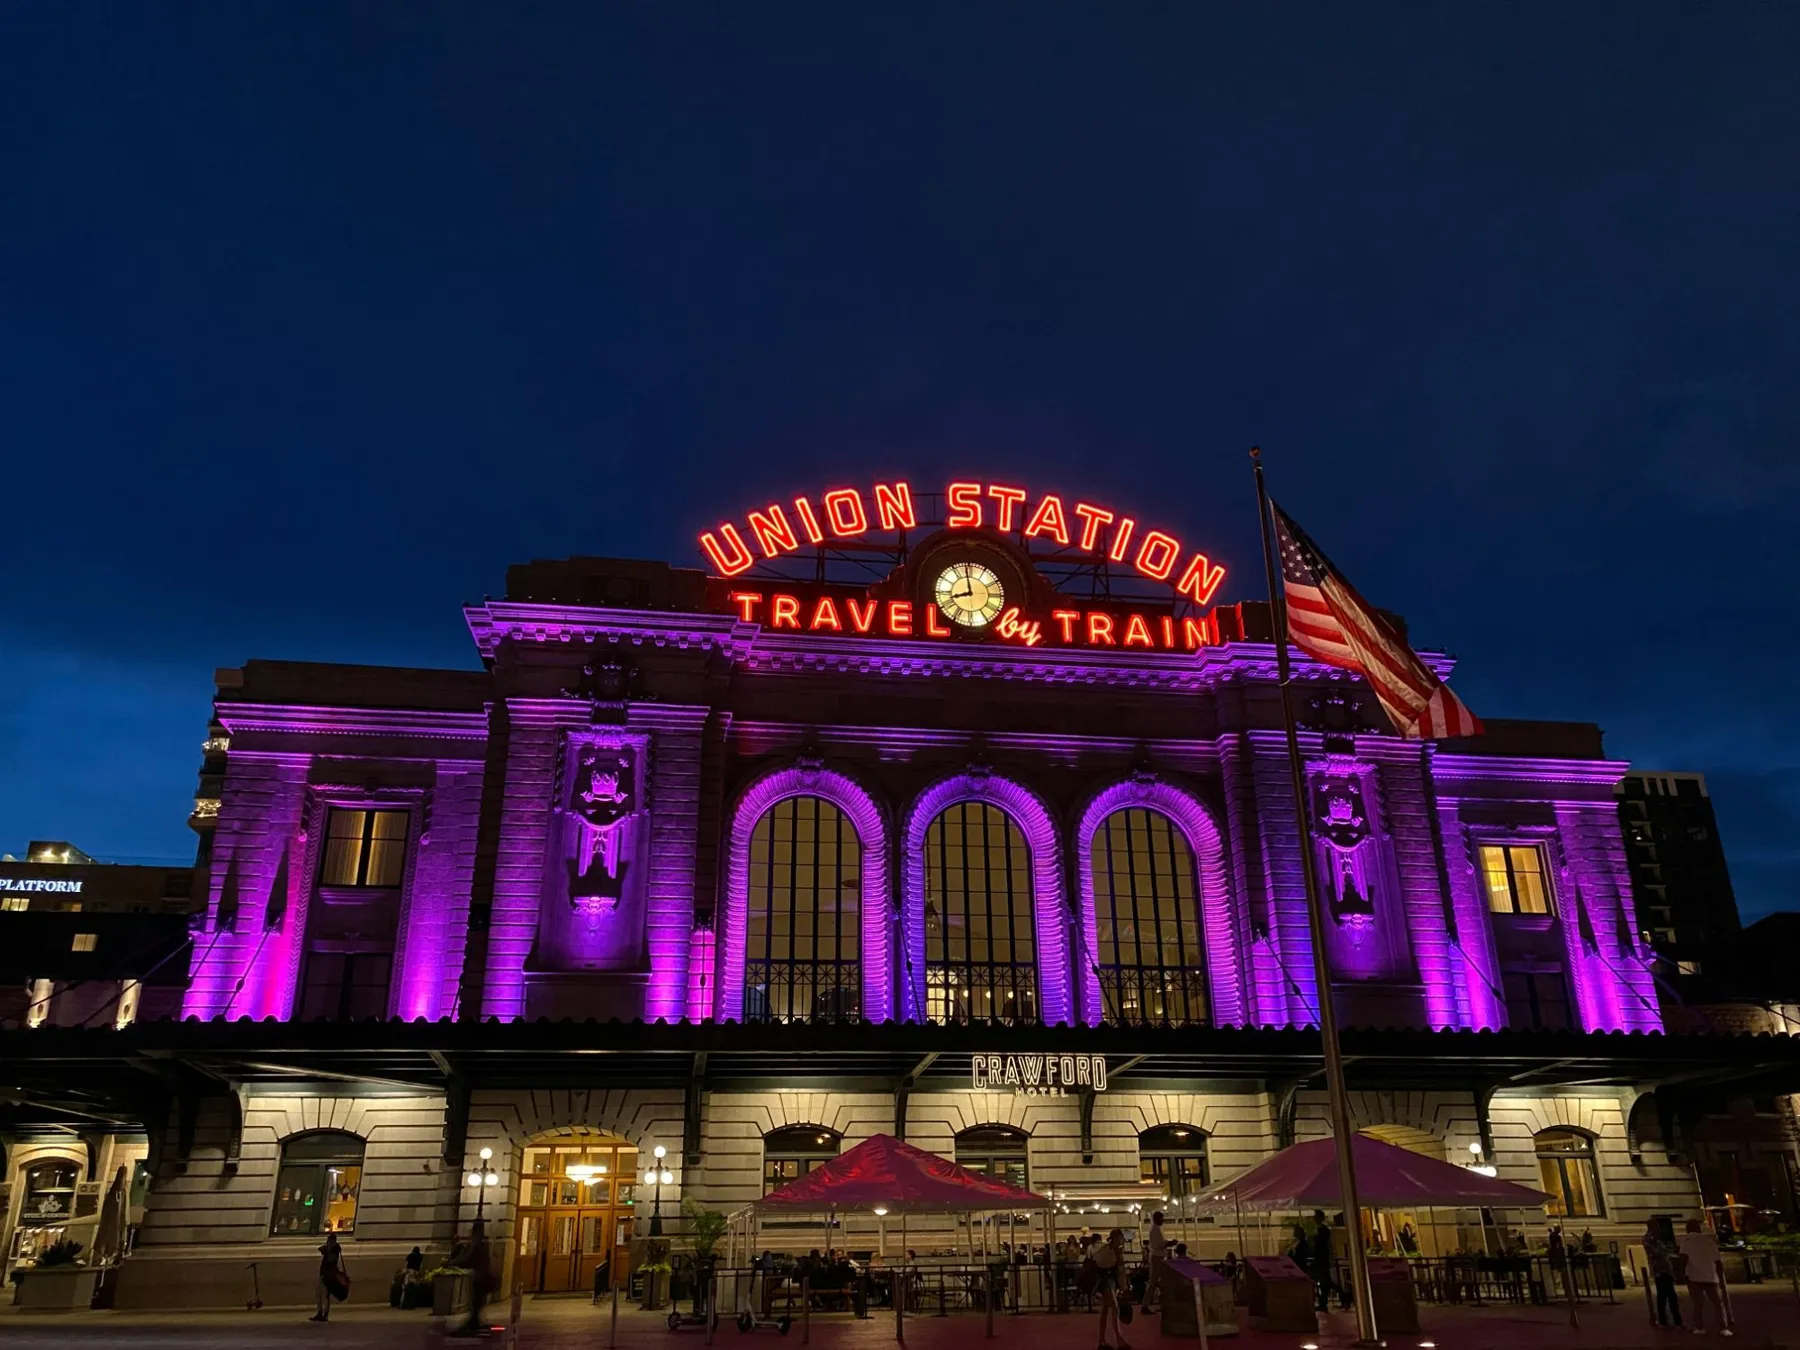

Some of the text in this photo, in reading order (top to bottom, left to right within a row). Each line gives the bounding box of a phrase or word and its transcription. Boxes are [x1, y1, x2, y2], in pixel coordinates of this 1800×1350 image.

[700, 482, 1226, 606] UNION STATION
[733, 591, 1210, 649] TRAVEL by TRAIN
[0, 879, 83, 893] PLATFORM
[972, 1055, 1107, 1091] CRAWFORD
[1015, 1087, 1069, 1098] HOTEL
